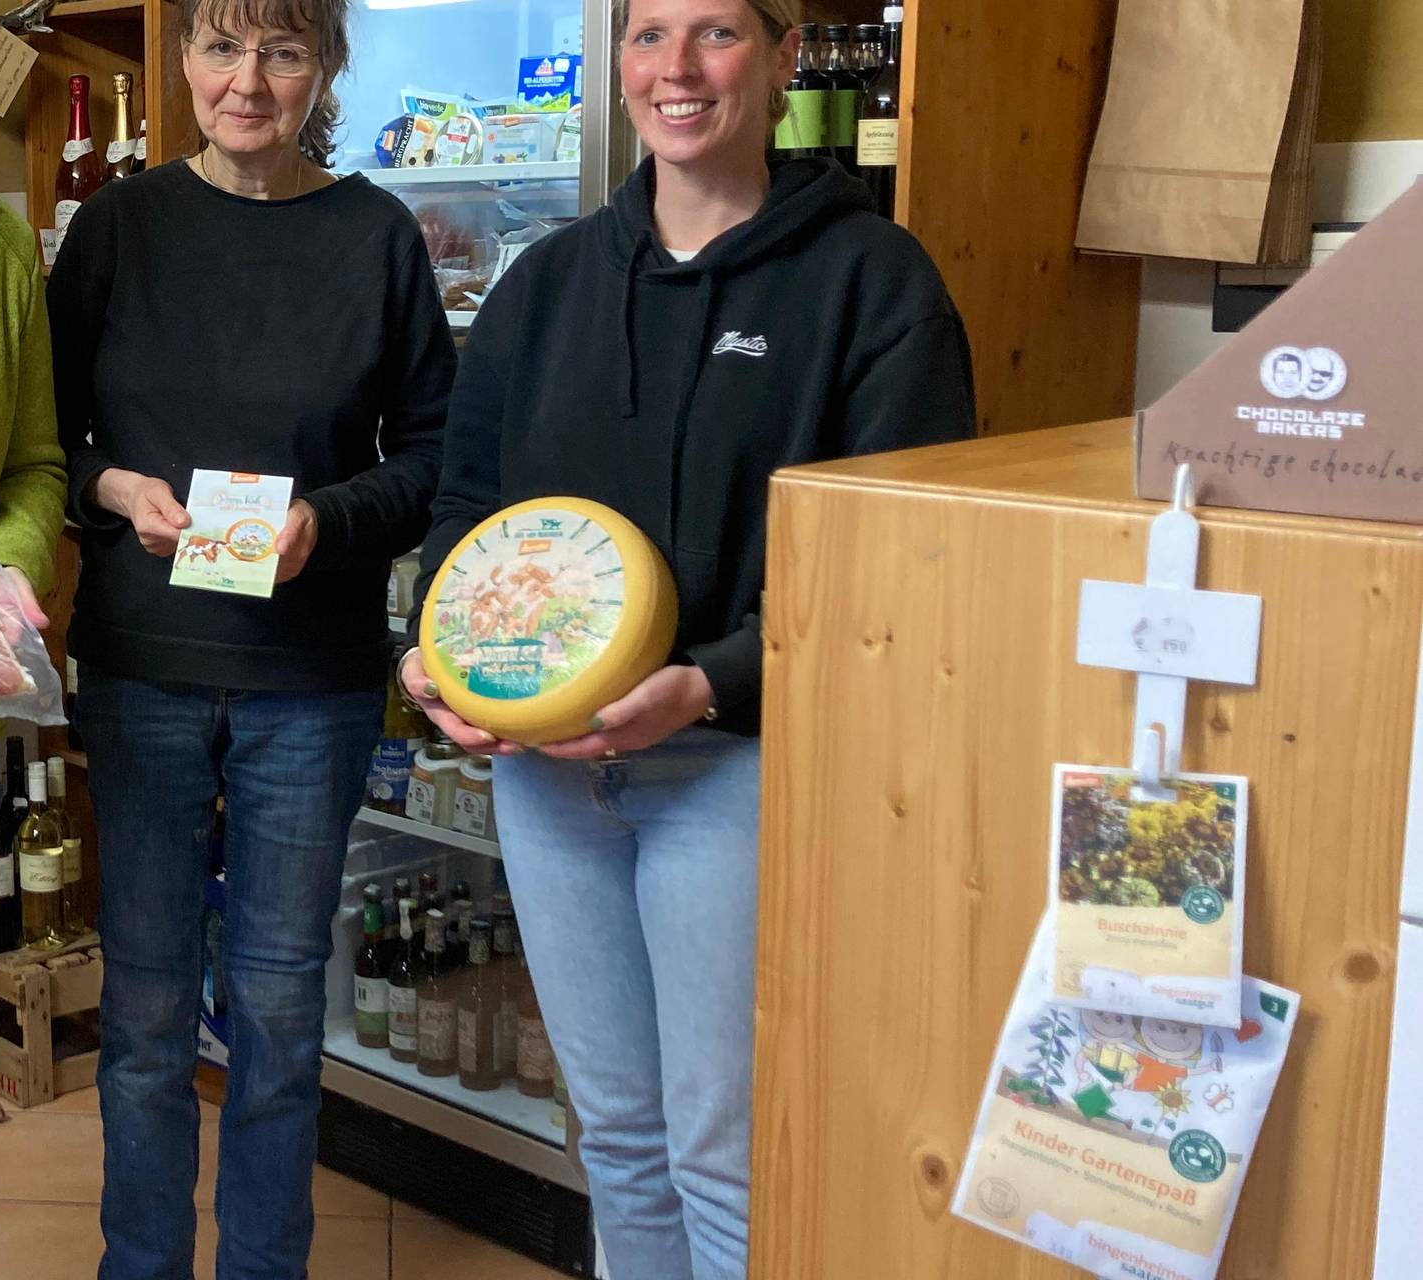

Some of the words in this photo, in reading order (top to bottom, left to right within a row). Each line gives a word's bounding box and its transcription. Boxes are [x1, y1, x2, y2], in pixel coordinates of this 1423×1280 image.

[1237, 405, 1366, 428] CHOCOLATE
[1257, 421, 1344, 440] MAKERS
[1013, 1119, 1078, 1158] Kinder
[1081, 1148, 1198, 1207] Gartenspaß
